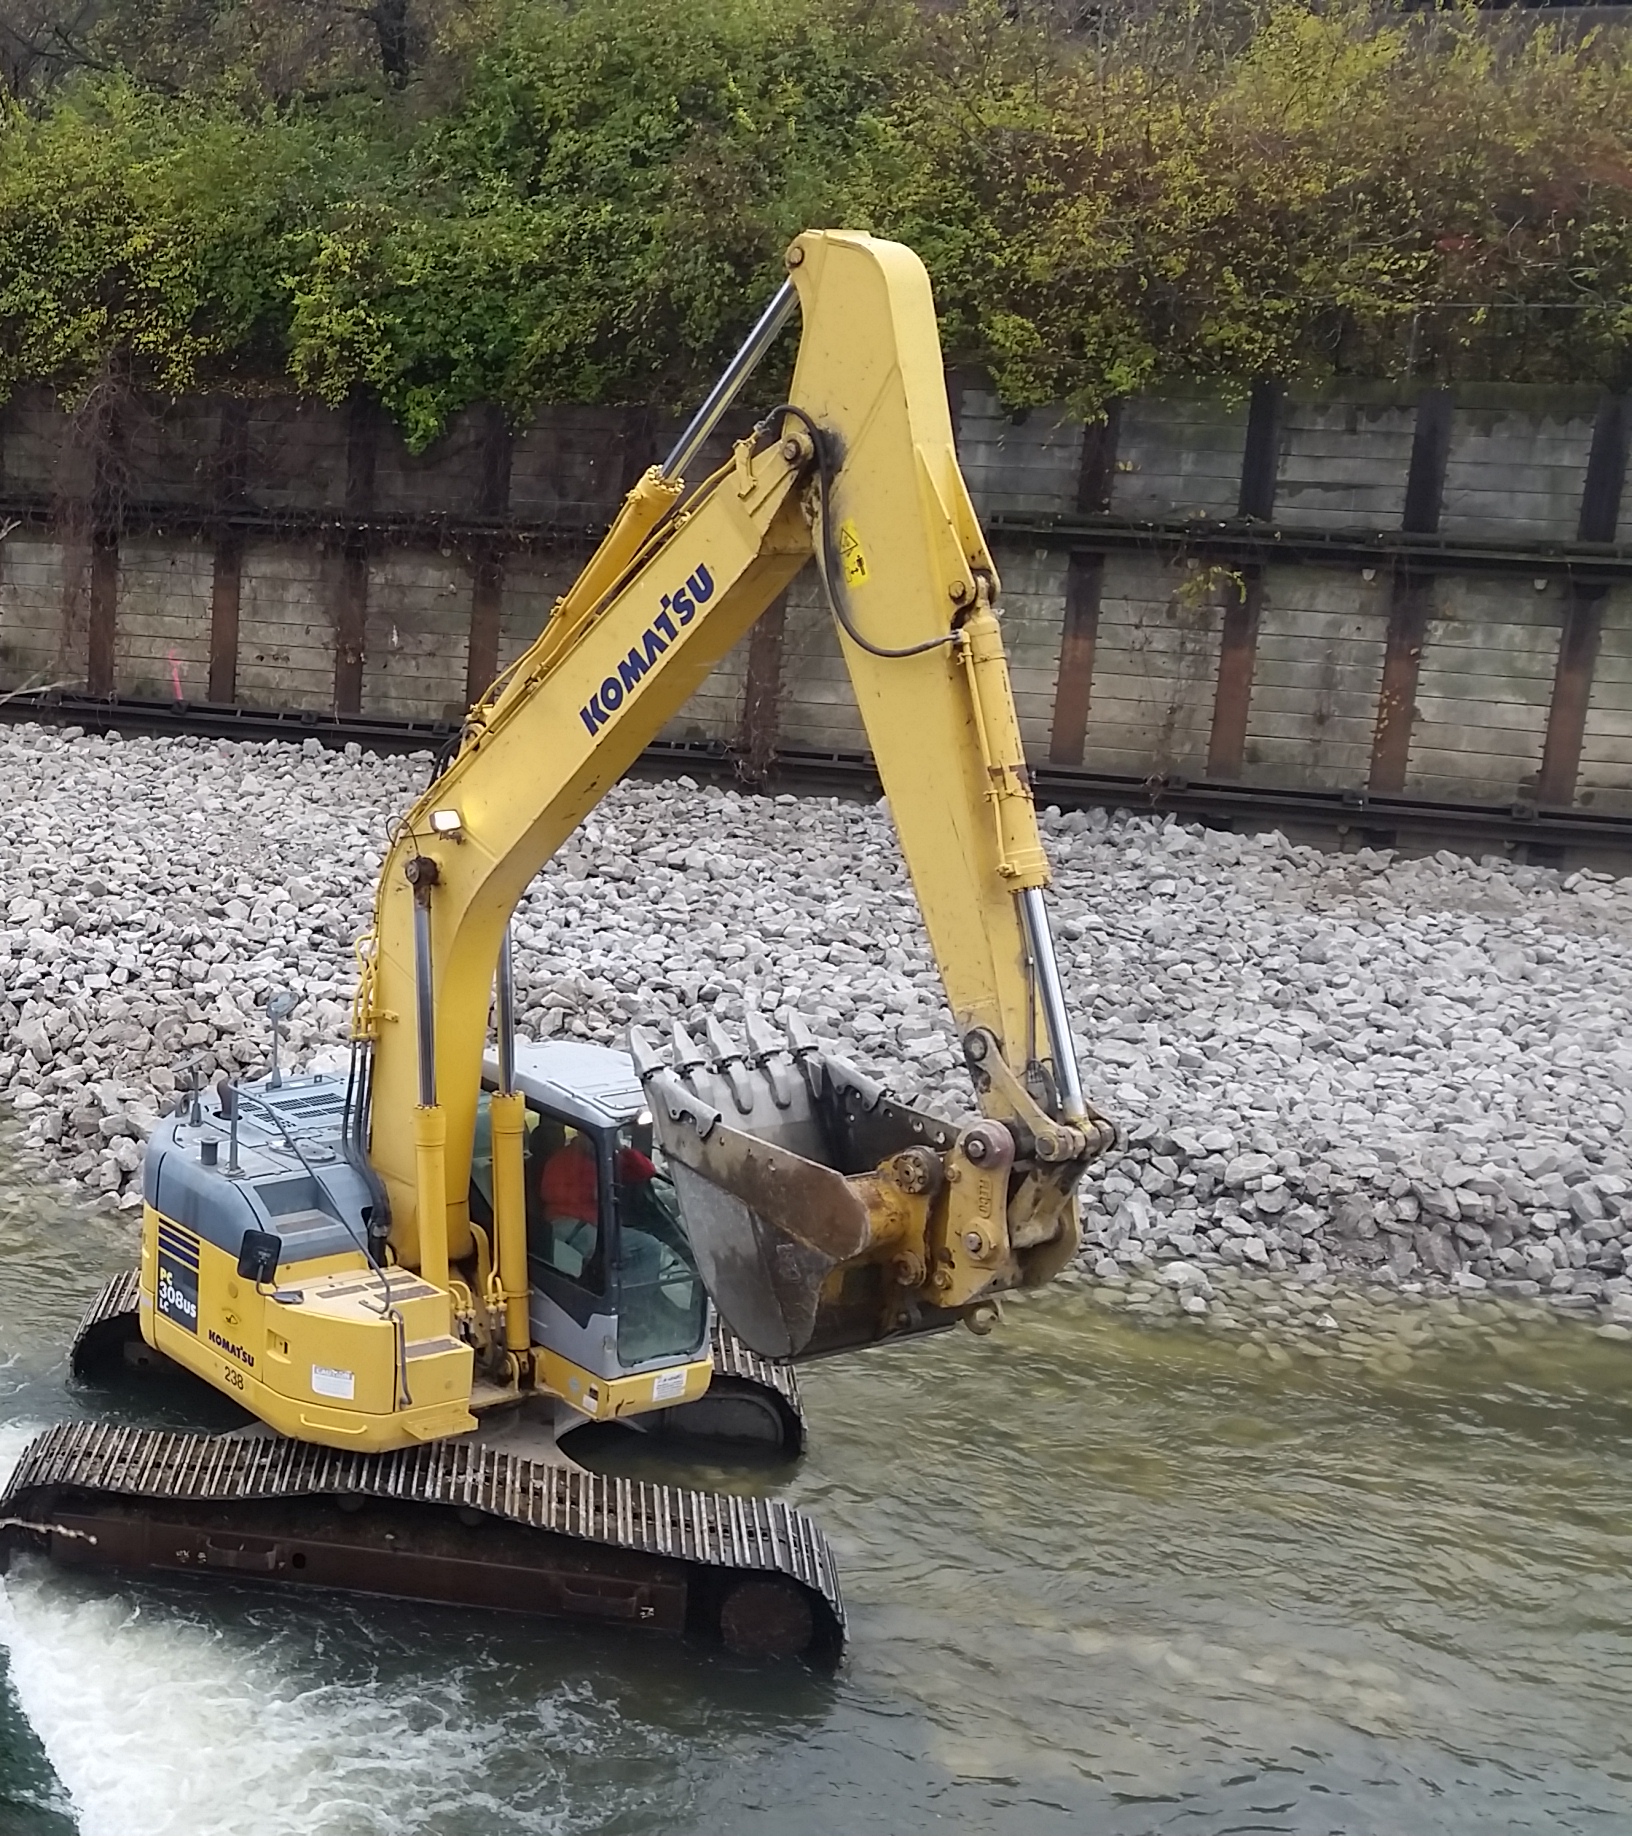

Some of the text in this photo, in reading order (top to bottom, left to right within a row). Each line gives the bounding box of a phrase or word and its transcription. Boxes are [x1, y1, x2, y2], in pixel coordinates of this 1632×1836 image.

[579, 563, 715, 737] KOMATSU
[159, 1266, 173, 1286] PC
[159, 1280, 197, 1318] 308US
[159, 1297, 170, 1313] LC
[208, 1328, 255, 1367] KOMATSU
[224, 1366, 244, 1390] 238
